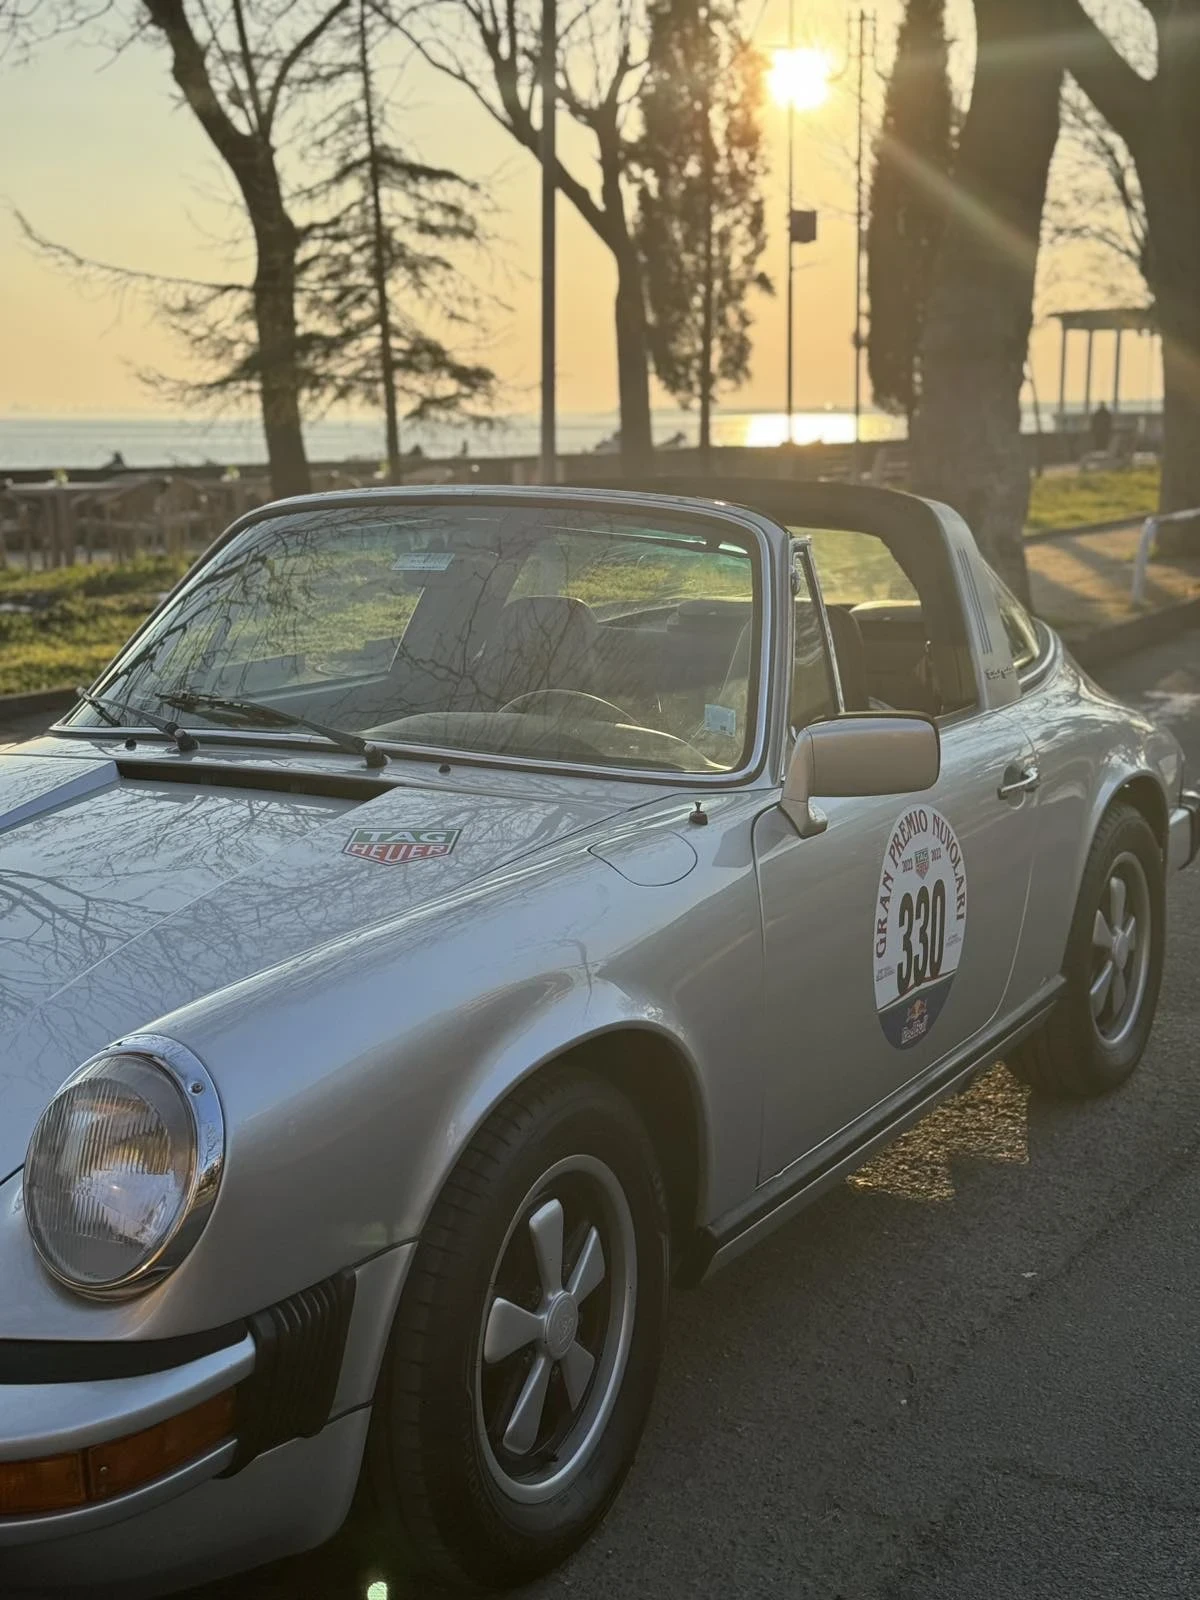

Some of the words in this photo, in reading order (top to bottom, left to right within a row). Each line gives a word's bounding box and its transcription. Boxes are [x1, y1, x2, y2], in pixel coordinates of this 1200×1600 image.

[350, 844, 445, 861] HEUER
[363, 831, 447, 843] TAG
[875, 869, 894, 959] GRAN
[888, 808, 929, 870] PREMIO
[932, 812, 966, 921] NUVOLARI
[896, 878, 946, 996] 330
